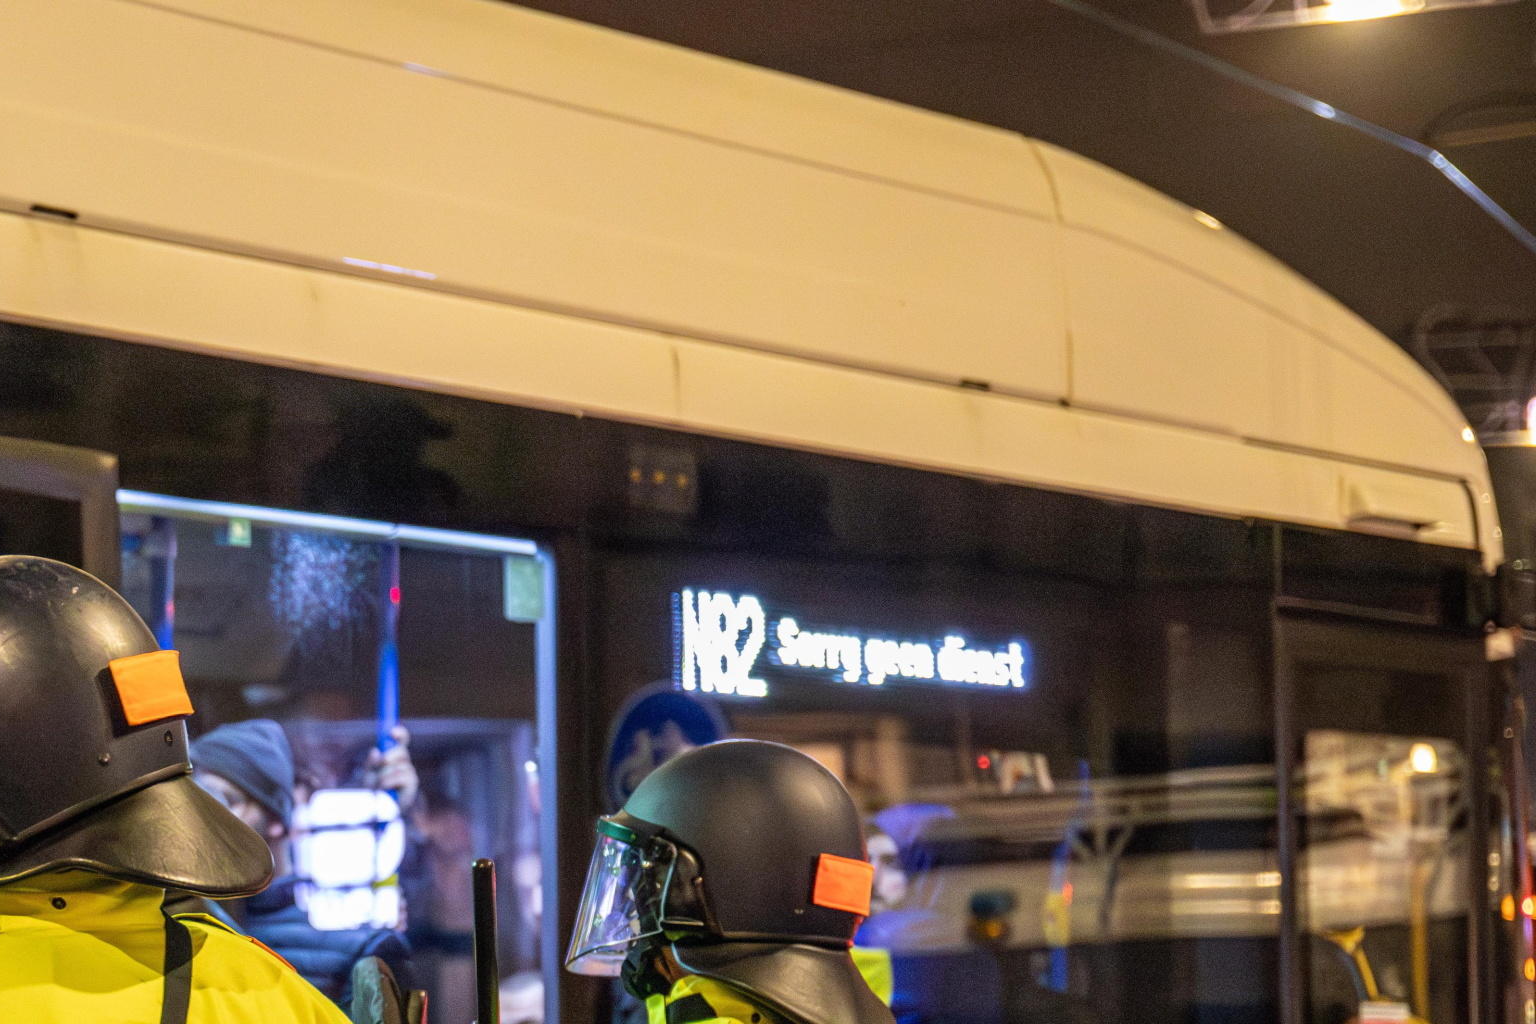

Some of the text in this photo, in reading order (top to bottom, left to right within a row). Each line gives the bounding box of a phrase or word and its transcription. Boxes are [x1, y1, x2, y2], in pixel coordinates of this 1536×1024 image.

[680, 589, 1025, 697] N82 Sorry geen dienst
